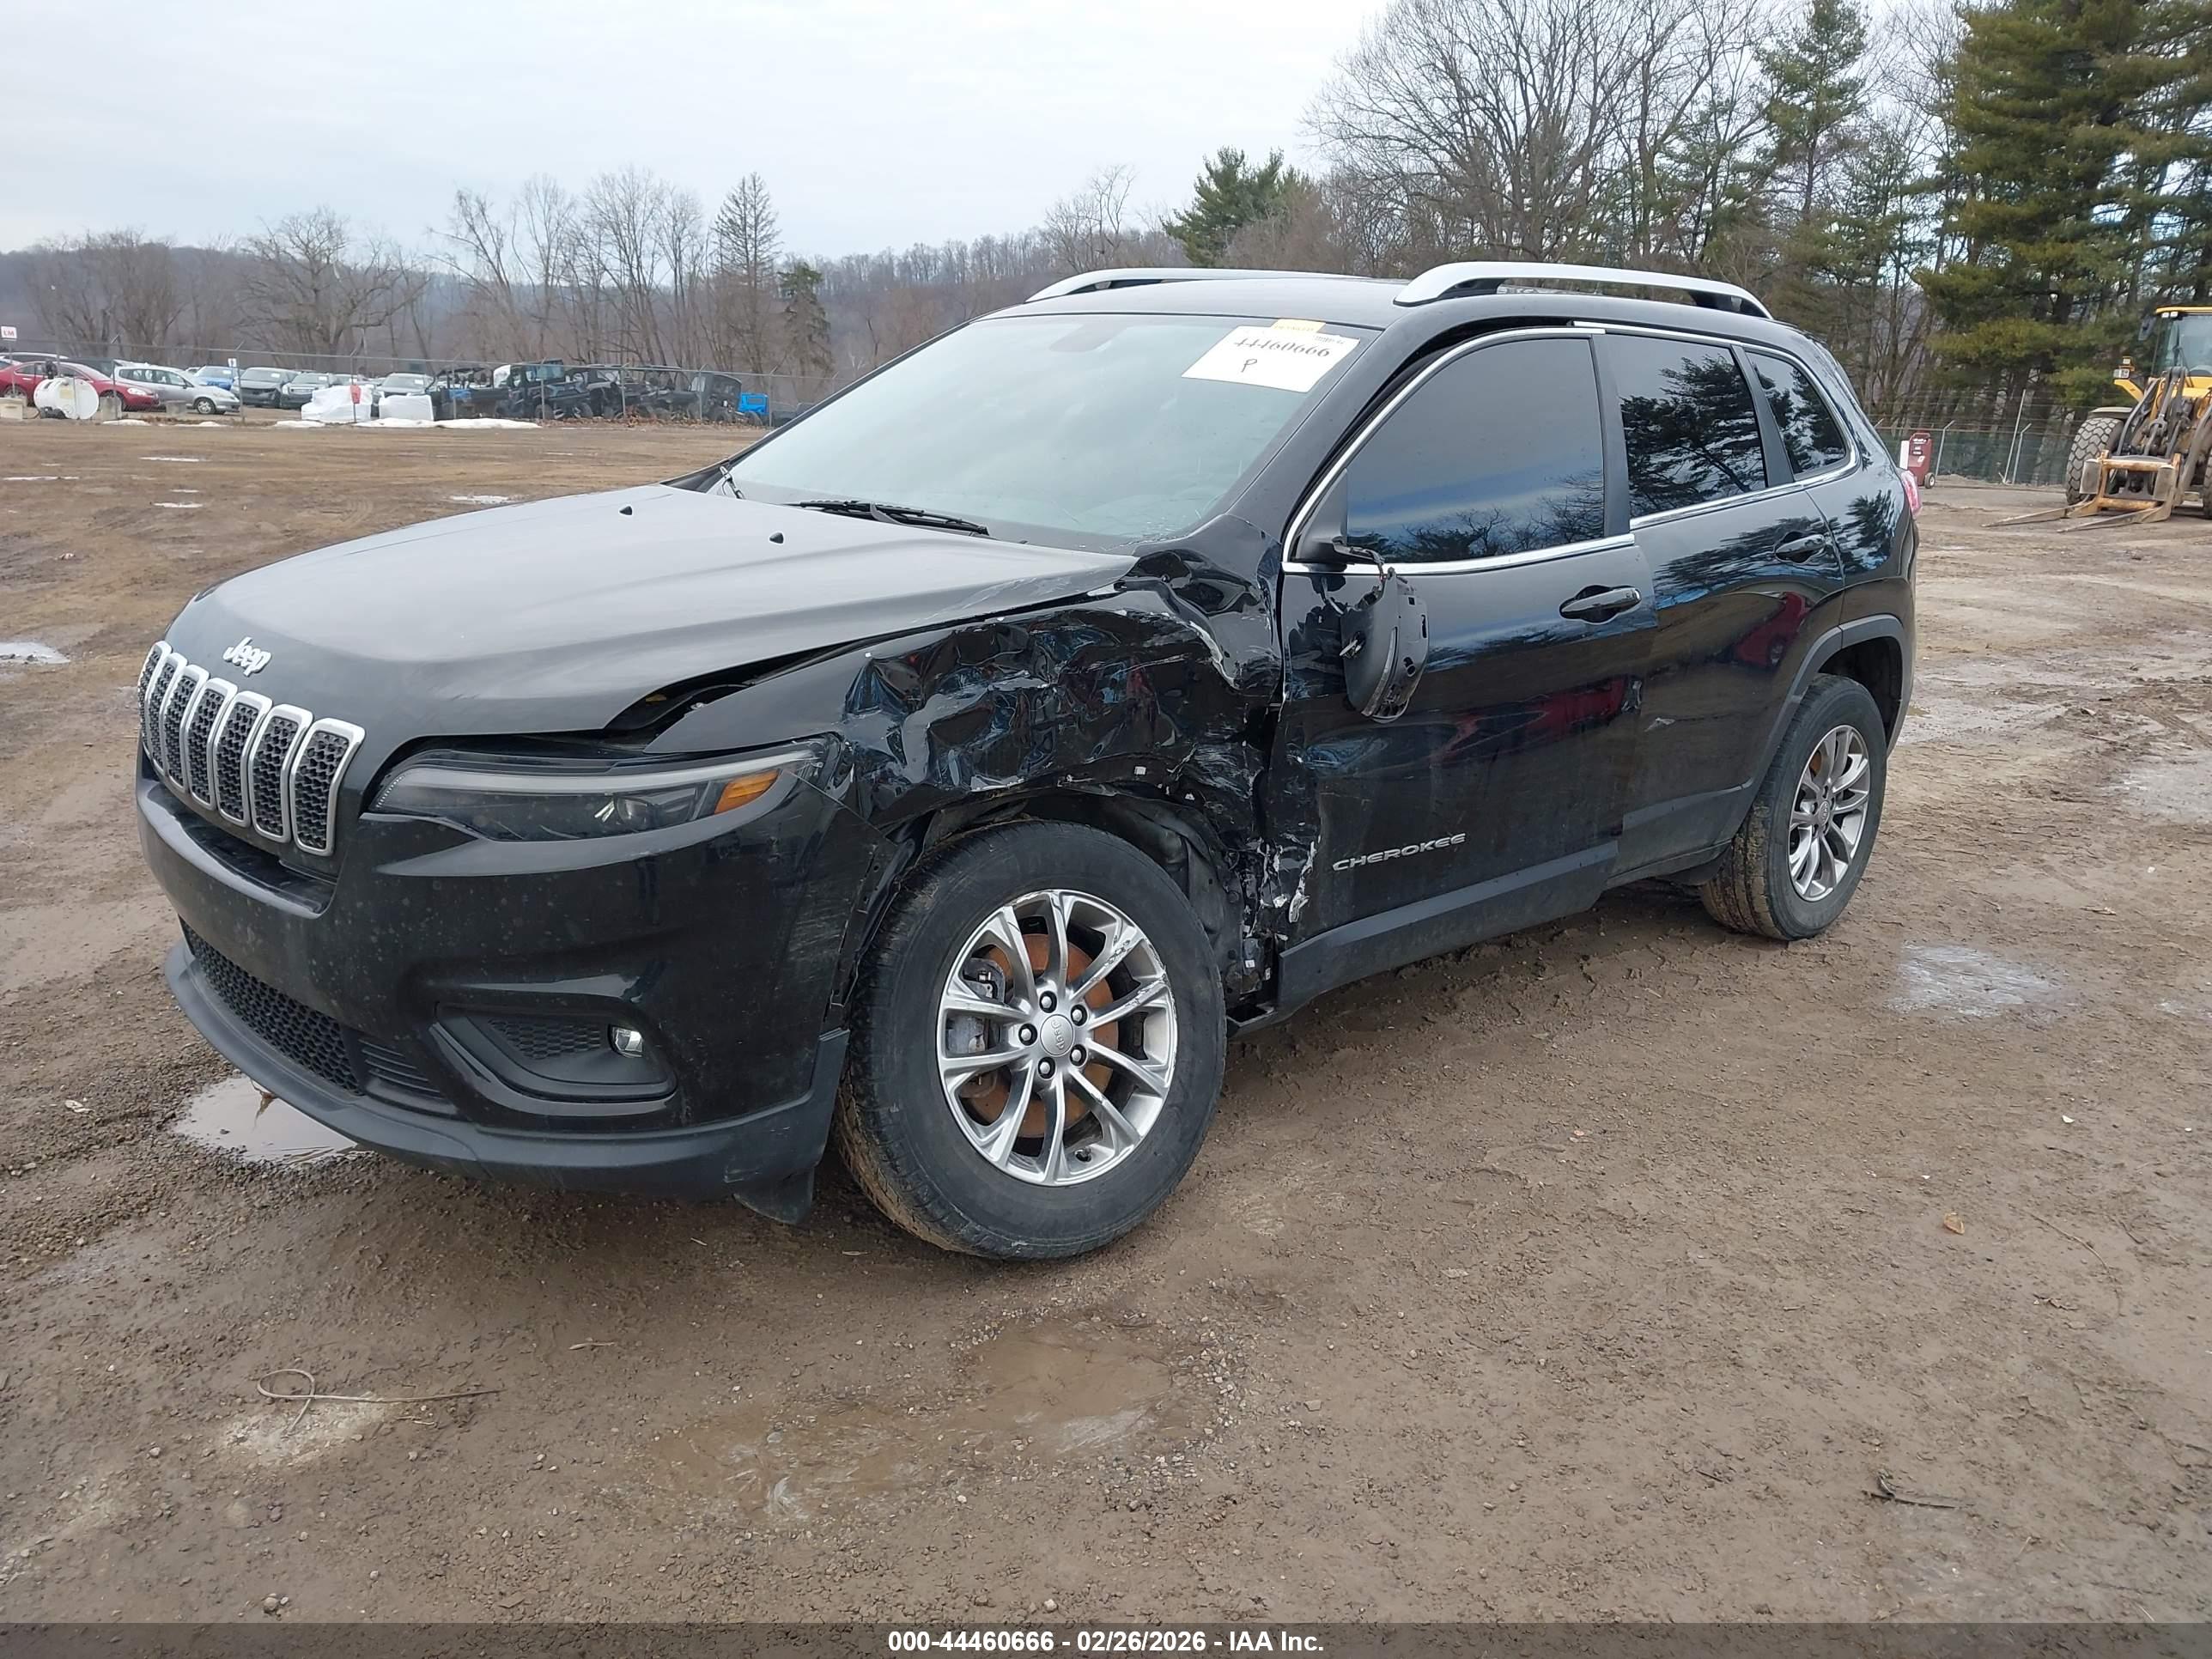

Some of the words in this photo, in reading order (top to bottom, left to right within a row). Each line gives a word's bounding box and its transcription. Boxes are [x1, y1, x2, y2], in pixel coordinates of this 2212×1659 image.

[1241, 359, 1258, 373] P
[222, 636, 272, 677] Jeep
[1332, 832, 1467, 872] CHEROKEE
[1051, 1019, 1065, 1050] Jeep
